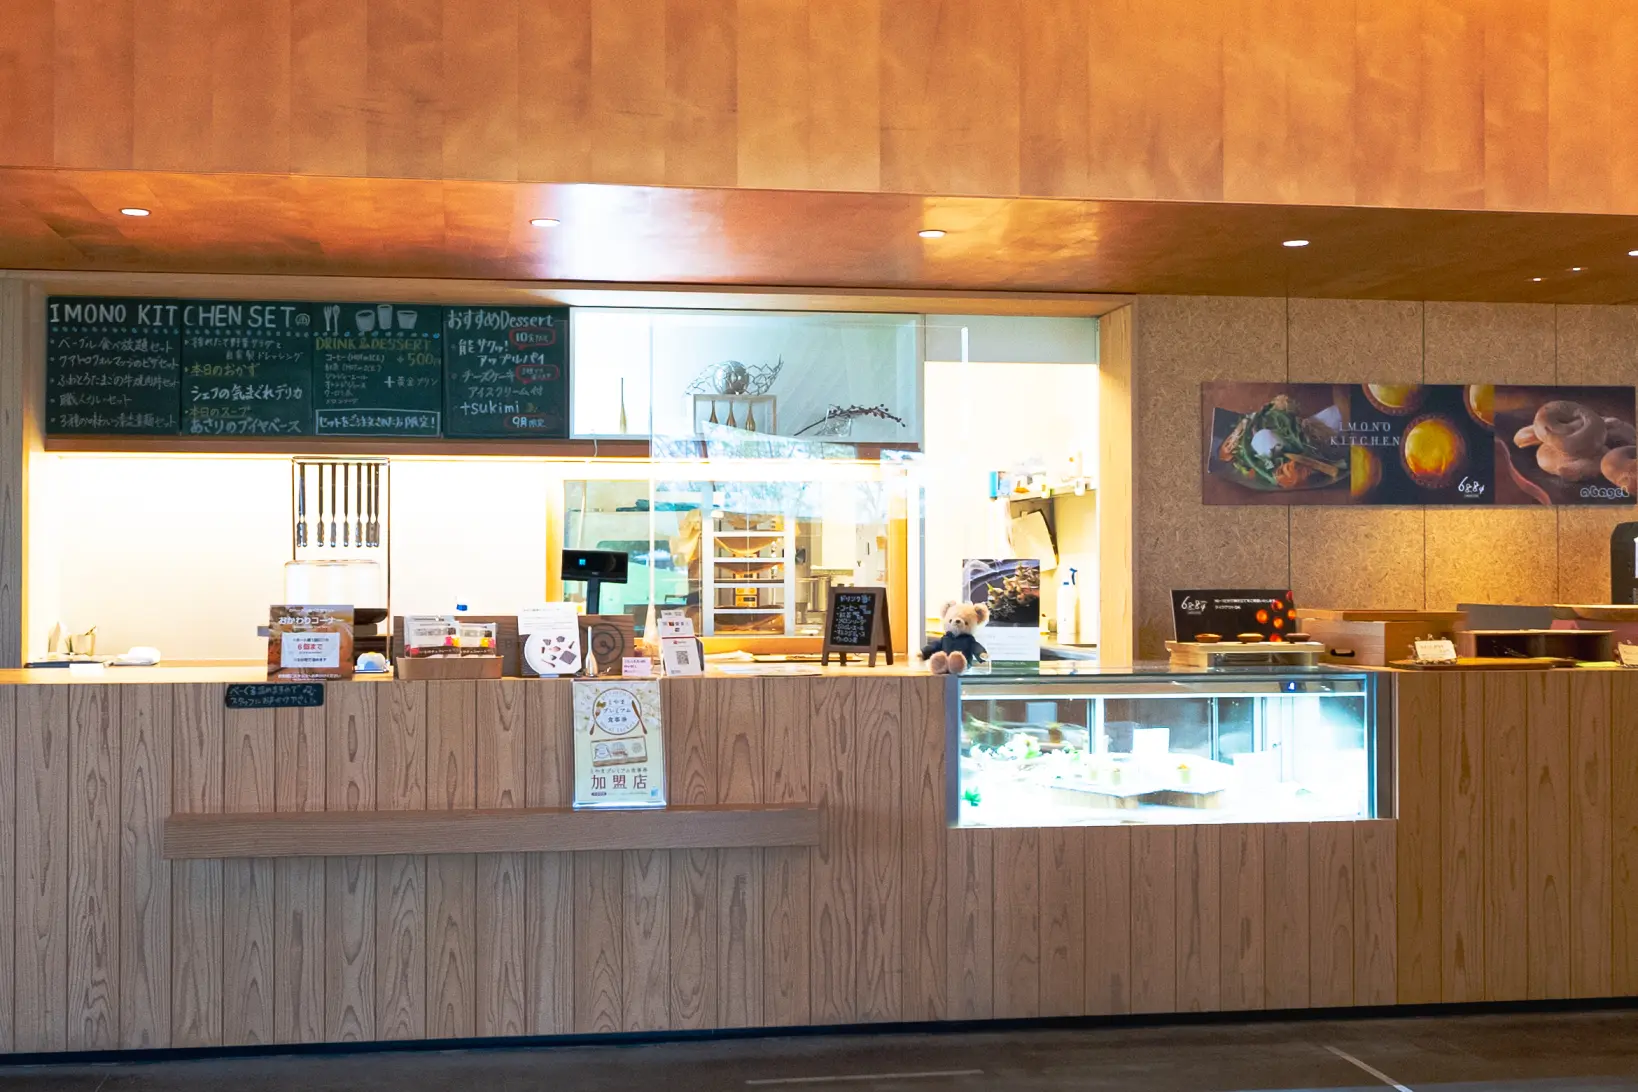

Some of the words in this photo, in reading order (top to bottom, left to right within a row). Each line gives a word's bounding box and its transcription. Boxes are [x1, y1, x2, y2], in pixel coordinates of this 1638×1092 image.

[50, 304, 127, 324] IMONO
[247, 305, 296, 328] SET
[315, 337, 356, 350] DRINK
[371, 338, 432, 351] DESSERT
[191, 361, 260, 377] 本日のおかず
[190, 383, 303, 401] シェフの気まぐれデリカ
[189, 405, 252, 418] 本日のスープ
[190, 417, 302, 434] あさりのブイヤベース
[1339, 421, 1392, 432] IMONO
[1330, 436, 1400, 446] KITCHEN
[278, 615, 345, 625] おかわりコーナー
[591, 774, 648, 790] 加盟店
